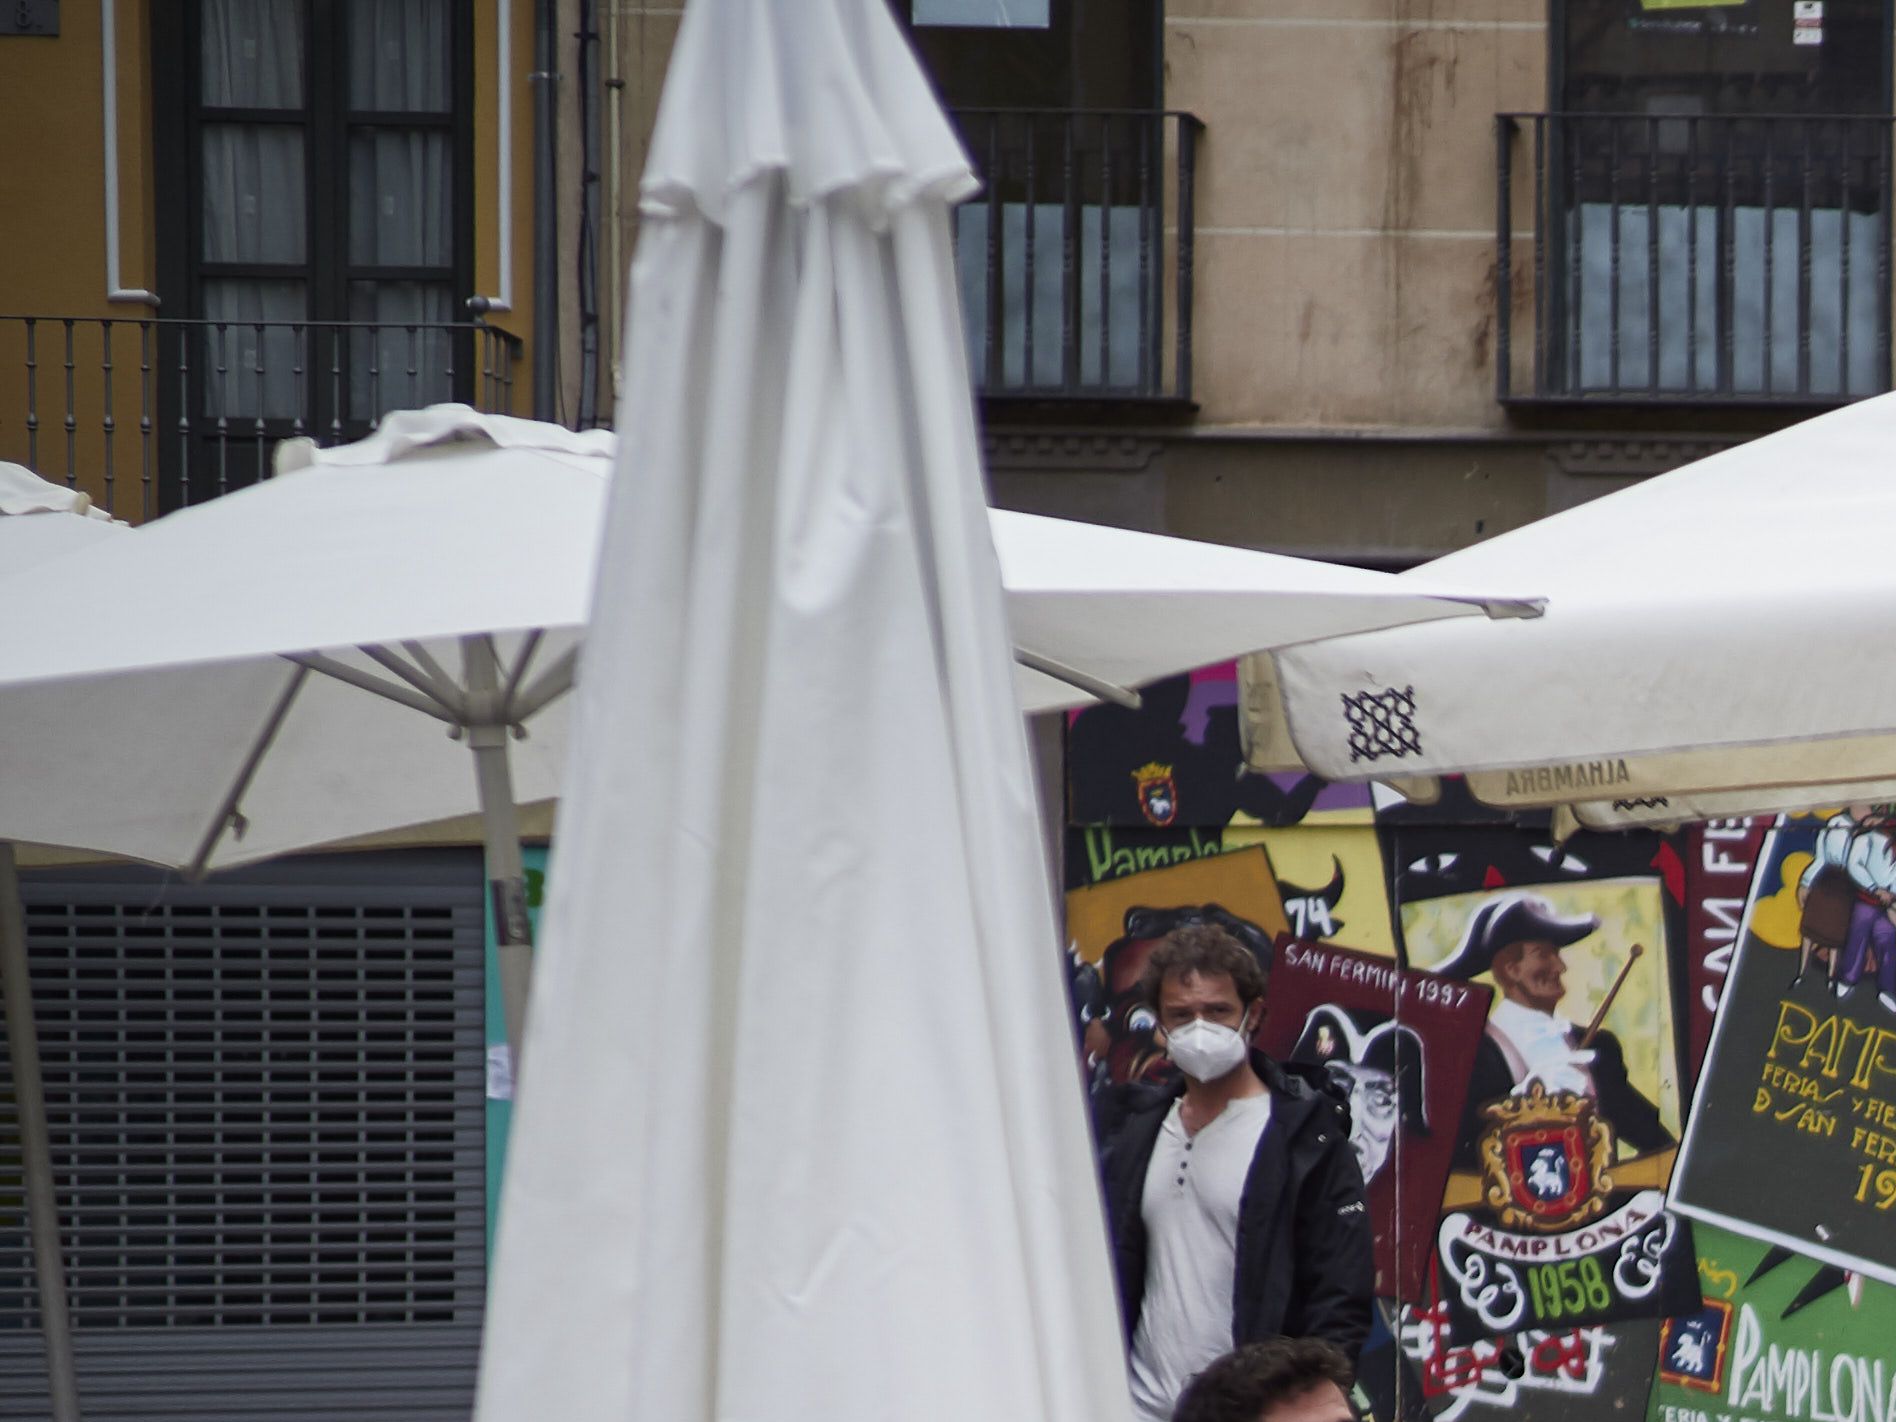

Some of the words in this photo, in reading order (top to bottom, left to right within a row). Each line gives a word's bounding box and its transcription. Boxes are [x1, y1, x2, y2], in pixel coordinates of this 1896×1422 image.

[1283, 942, 1327, 977] SAN
[1329, 952, 1407, 997] FERMIN
[1774, 1102, 1838, 1137] SAN
[1462, 1206, 1648, 1258] PAMPLONA
[1526, 1255, 1612, 1321] 1958
